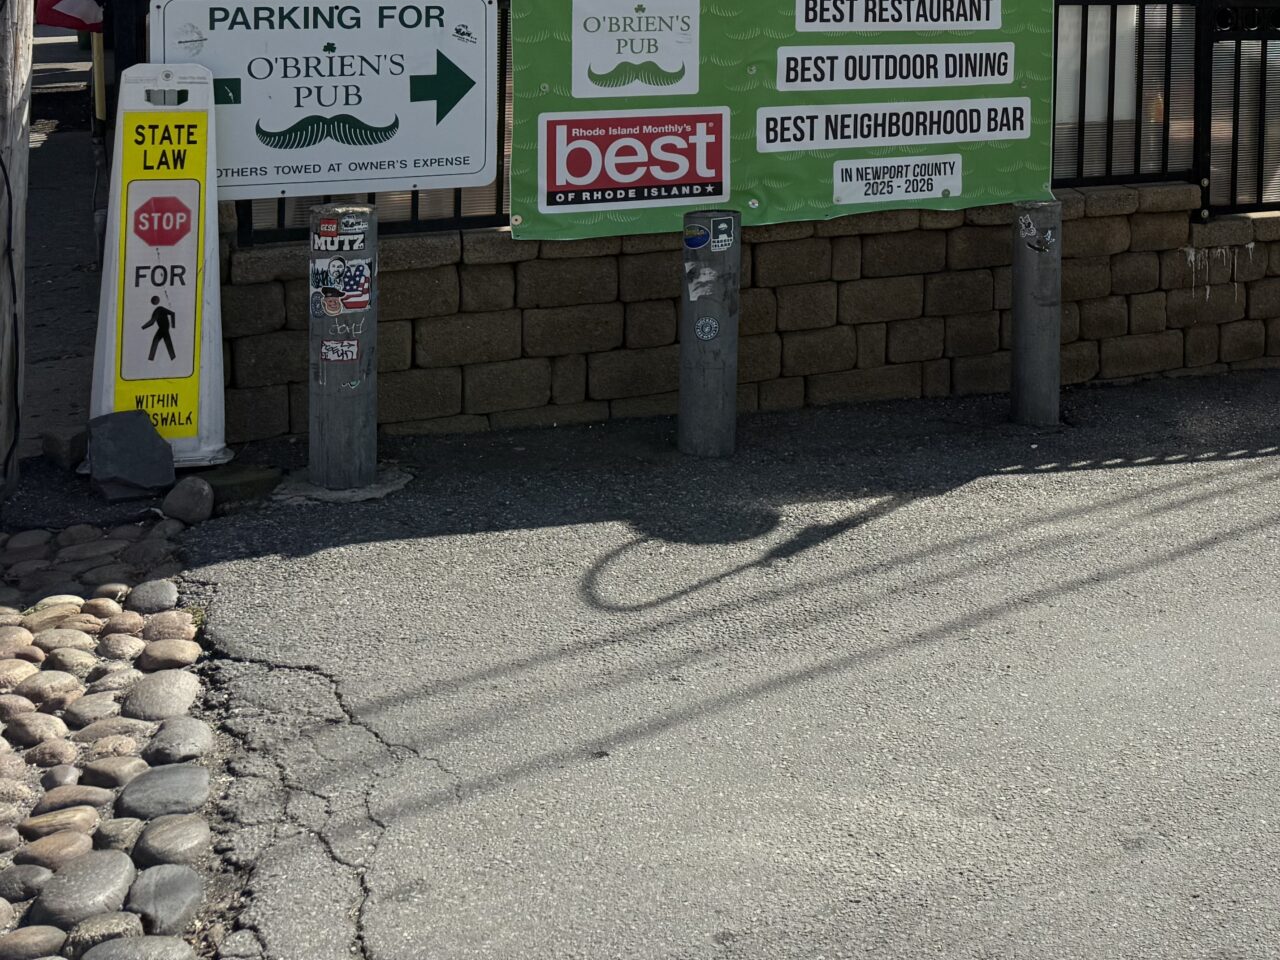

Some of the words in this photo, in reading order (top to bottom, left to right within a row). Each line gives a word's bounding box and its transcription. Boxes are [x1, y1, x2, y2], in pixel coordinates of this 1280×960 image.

[209, 5, 362, 30] PARKING
[378, 5, 445, 29] FOR
[583, 15, 691, 33] O'BRIEN'S
[616, 37, 659, 55] PUB
[247, 53, 405, 80] O'BRIEN'S
[785, 55, 839, 83] BEST
[844, 53, 939, 82] OUTDOOR
[945, 51, 1009, 79] DINING
[293, 83, 363, 108] PUB
[134, 124, 198, 146] STATE
[572, 127, 606, 137] Rhode
[608, 126, 640, 135] Island
[642, 123, 692, 135] Monthly's
[764, 115, 819, 144] BEST
[824, 107, 982, 141] NEIGHBORHOOD
[986, 106, 1025, 133] BAR
[143, 149, 187, 170] LAW
[555, 122, 716, 186] best
[217, 166, 268, 179] OTHERS
[273, 164, 322, 176] TOWED
[327, 162, 343, 173] AT
[348, 159, 408, 172] OWNER'S
[413, 155, 471, 169] EXPENSE
[840, 167, 853, 182] IN
[855, 163, 911, 182] NEWPORT
[912, 161, 956, 178] COUNTY
[556, 192, 576, 202] OF
[582, 189, 636, 201] RHODE
[644, 185, 702, 198] ISLAND
[864, 180, 895, 197] 2025
[904, 178, 934, 194] 2026
[138, 212, 188, 230] STOP
[134, 264, 186, 288] FOR
[135, 393, 179, 409] WITHIN
[149, 410, 193, 427] SWALK
